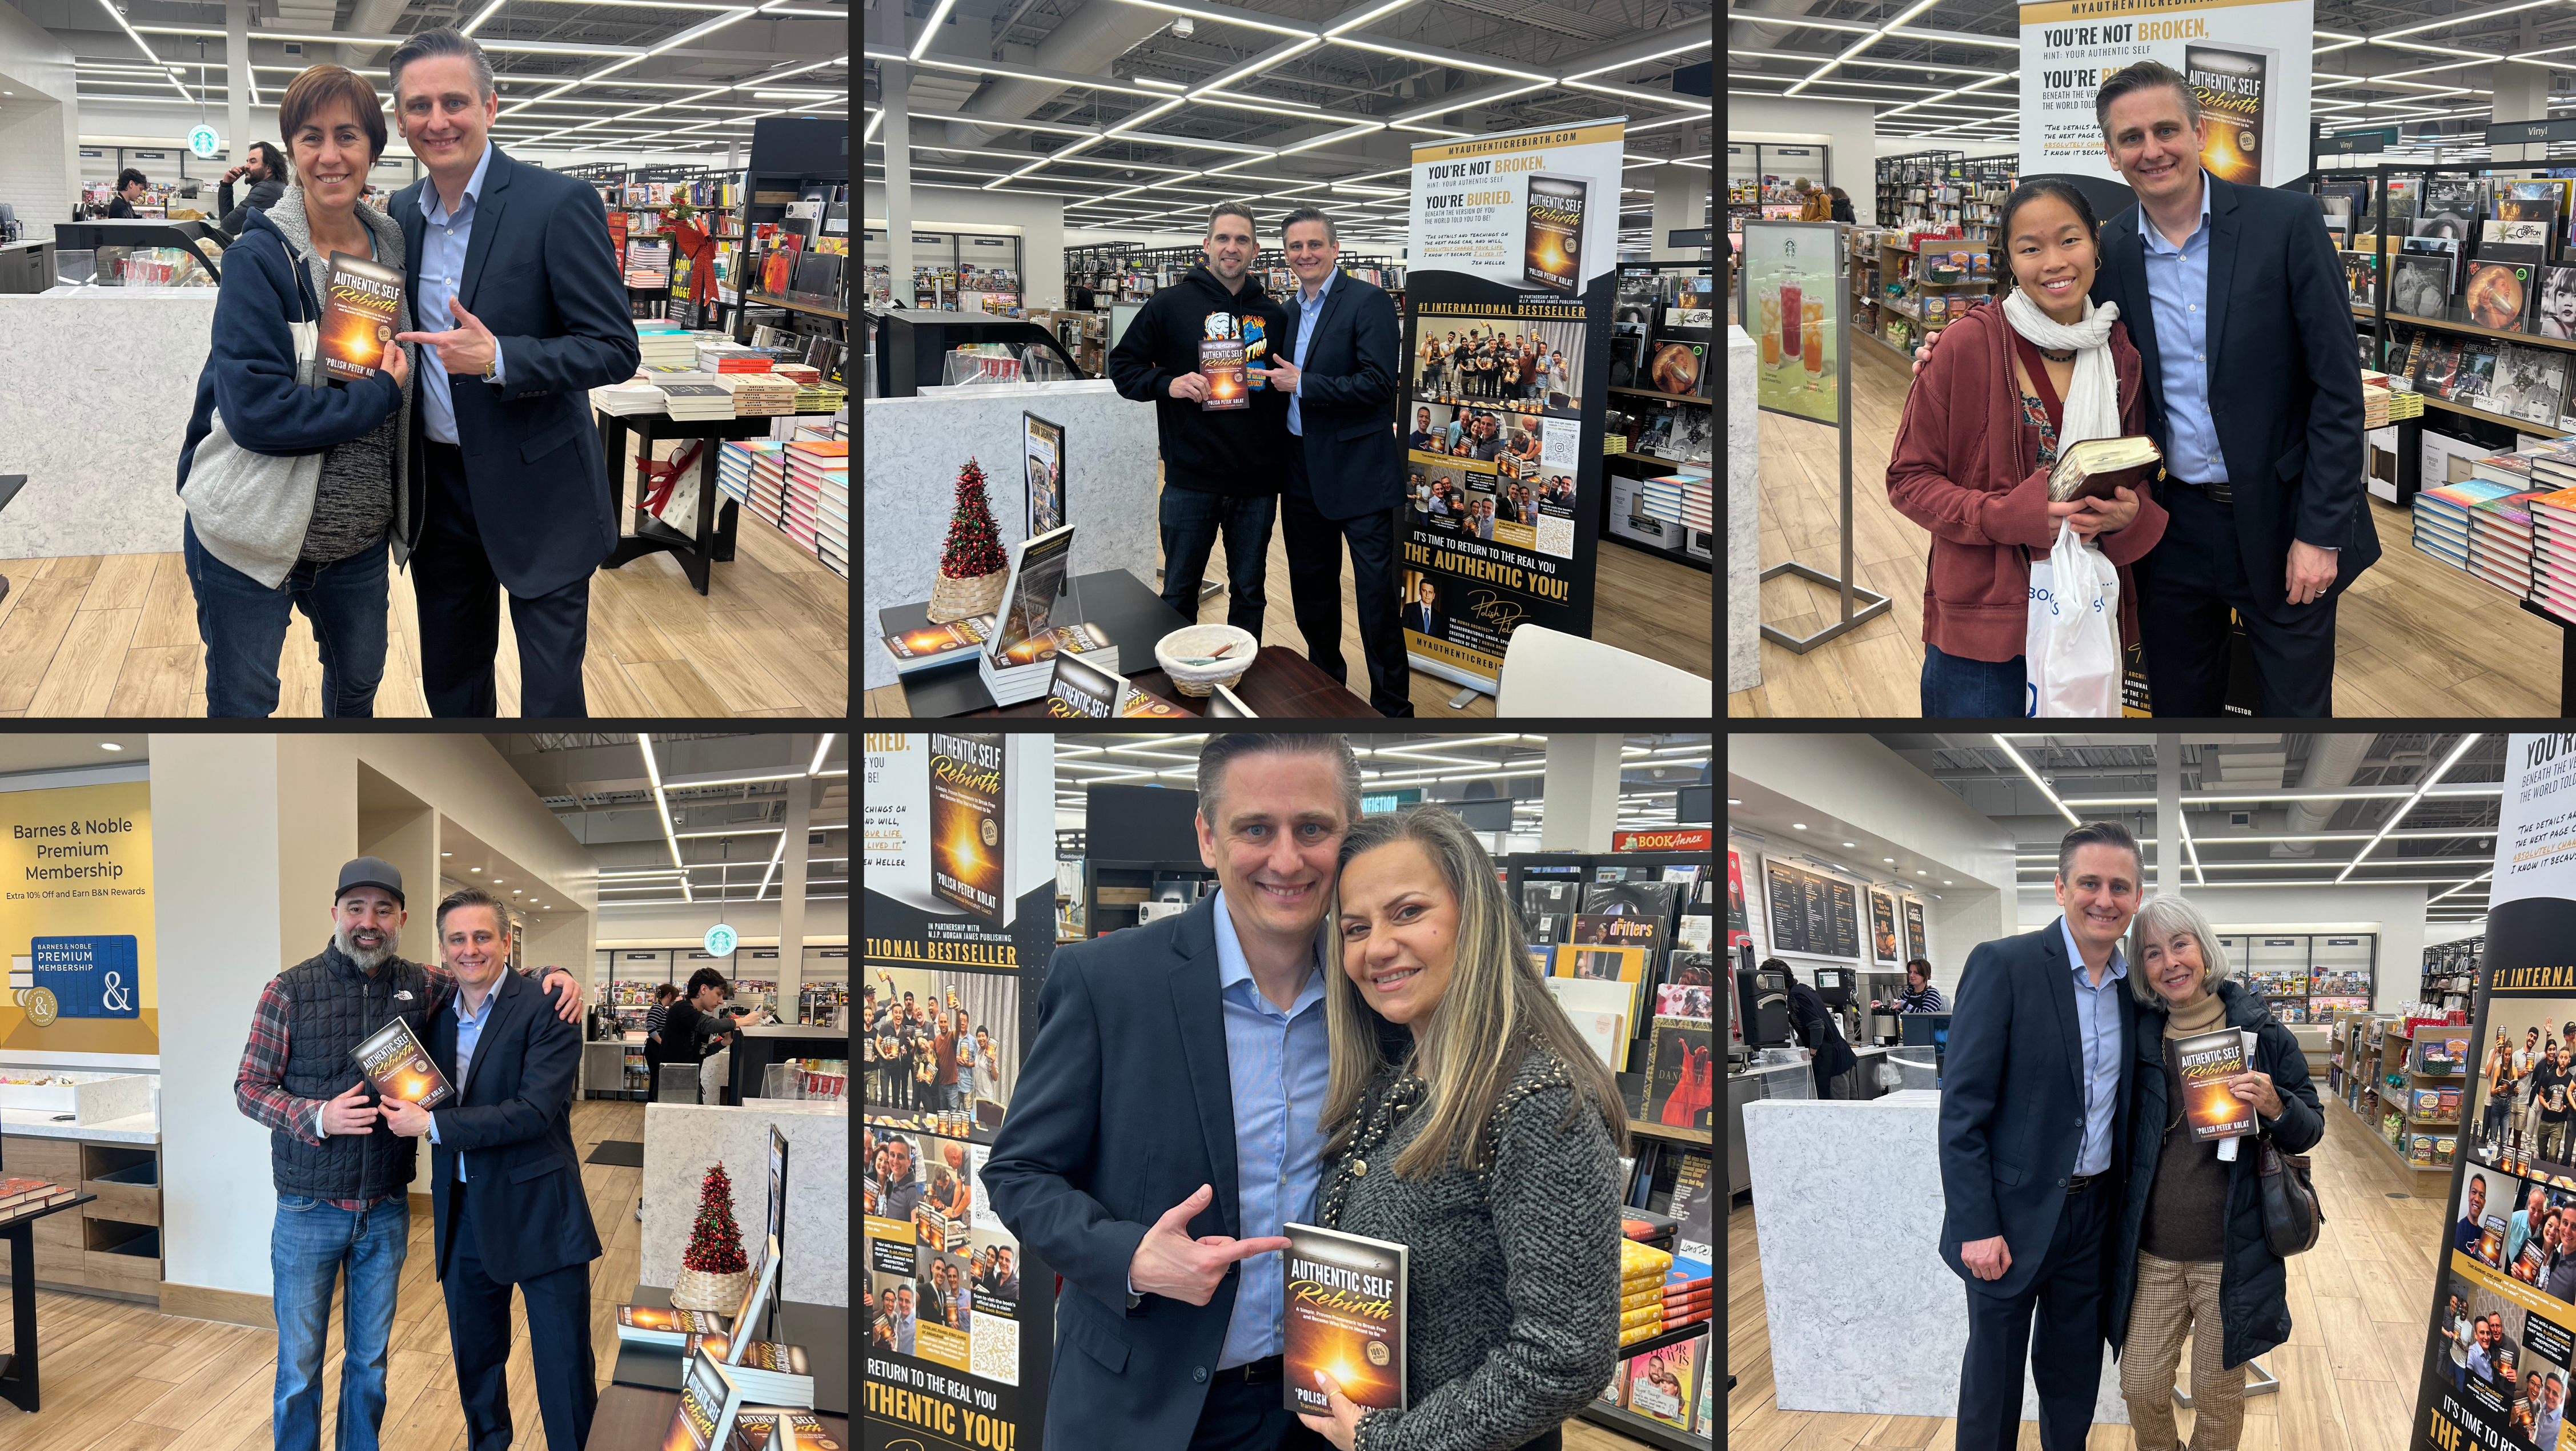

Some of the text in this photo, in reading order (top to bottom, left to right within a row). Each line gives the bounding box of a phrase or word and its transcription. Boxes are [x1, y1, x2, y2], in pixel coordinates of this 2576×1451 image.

[2044, 18, 2209, 48] YOU'RE NOT BROKEN,
[2528, 126, 2547, 135] Vinyl
[1449, 132, 1576, 155] MYAUTHENTICREBIRTH.COM
[1429, 155, 1546, 180] YOU'RE NOT BROKEN,
[1427, 191, 1514, 209] YOU'RE BURIED.
[1530, 193, 1582, 212] AUTHENTIC SELF
[1528, 206, 1580, 226] Rebirth
[2516, 228, 2541, 238] CLAPTON
[675, 259, 690, 271] BOOK
[334, 271, 400, 300] AUTHENTIC SELF
[672, 286, 690, 298] DAGGE
[331, 286, 398, 312] Rebirth
[1418, 303, 1586, 316] #1 INTERNATIONAL BESTSELLER
[2463, 343, 2498, 354] ABBEY ROAD
[348, 363, 366, 374] PETER'
[366, 368, 375, 377] KOL
[1202, 357, 1243, 368] Rebirth
[2475, 396, 2493, 406] Beatles
[2510, 410, 2529, 419] REVOLVER
[2483, 483, 2512, 492] SOME
[1414, 531, 1555, 574] IT'S TIME TO RETURN TO THE REAL YOU
[1404, 541, 1568, 601] THE AUTHENTIC YOU!
[1449, 637, 1464, 645] FOUNDER
[1478, 644, 1490, 653] OMEGA
[932, 733, 1001, 770] AUTHENTIC SELF
[930, 755, 1001, 794] Rebirth
[2522, 762, 2566, 788] BENEATH THE
[2519, 780, 2558, 803] THE WORLD
[14, 818, 132, 839] Barnes & Noble
[1638, 833, 1703, 847] BOOK Annex
[37, 842, 109, 858] Premium
[2513, 846, 2556, 862] ABSOLUTELY
[26, 862, 123, 880] Membership
[56, 889, 70, 898] and
[111, 887, 145, 896] Rewards
[1909, 912, 1921, 922] COOKIES
[1610, 921, 1653, 937] drifters
[38, 952, 93, 961] PREMIUM
[928, 942, 1016, 964] BESTSELLER
[2493, 969, 2505, 986] #1
[363, 1032, 410, 1070] AUTHENTIC SELF
[369, 1041, 415, 1078] Rebirth
[2182, 1046, 2239, 1067] AUTHENTIC SELF
[2182, 1057, 2243, 1081] Rebirth
[2217, 1123, 2232, 1132] PETER'
[2234, 1120, 2249, 1129] KOLAT
[1291, 1259, 1393, 1299] AUTHENTIC SELF
[1288, 1280, 1394, 1320] Rebirth
[2444, 1394, 2498, 1448] IT'S TIME TO
